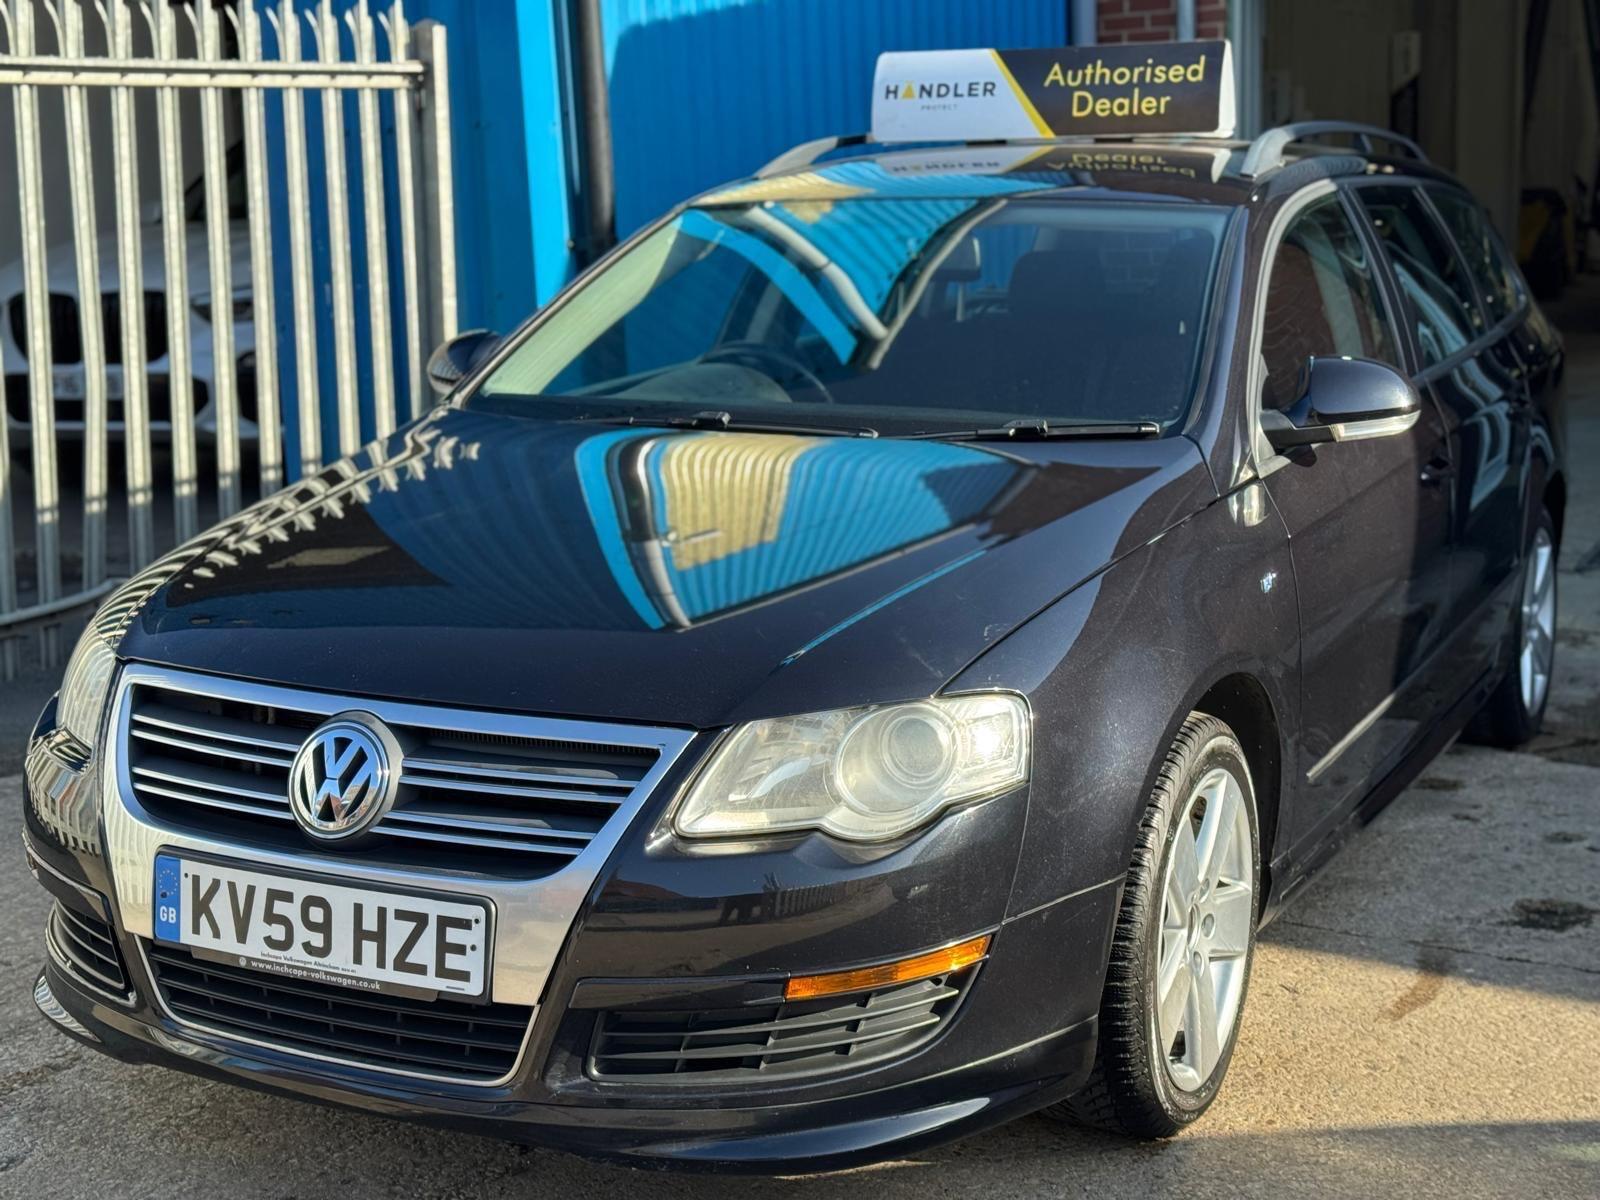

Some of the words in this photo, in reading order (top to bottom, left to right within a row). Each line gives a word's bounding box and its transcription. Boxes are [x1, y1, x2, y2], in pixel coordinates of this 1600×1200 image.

[1043, 54, 1206, 88] Authorised
[1072, 87, 1171, 118] Dealer
[159, 905, 177, 924] GB
[192, 874, 332, 959] KV59
[353, 902, 472, 983] HZE
[251, 960, 380, 990] www.inchcape-volkswagen.co.uk
